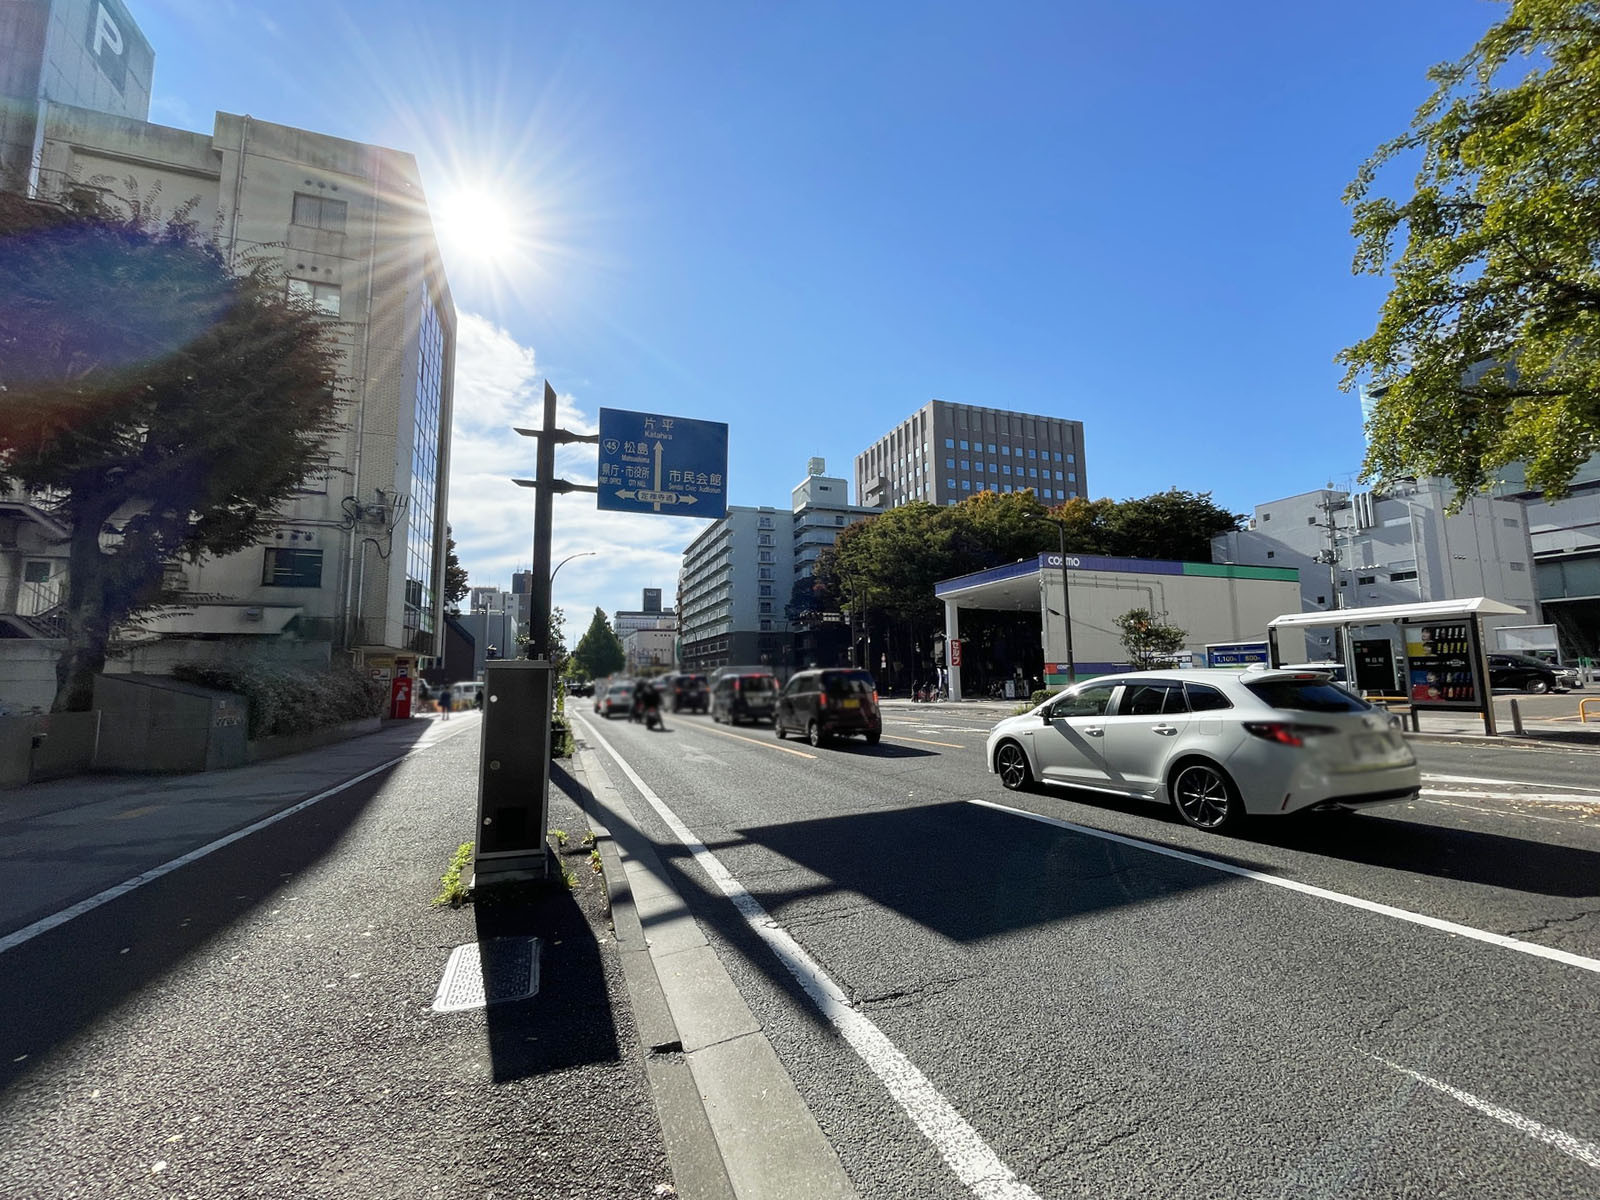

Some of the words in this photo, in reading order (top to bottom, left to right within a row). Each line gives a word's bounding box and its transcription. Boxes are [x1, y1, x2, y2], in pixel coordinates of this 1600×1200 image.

[93, 1, 123, 55] P
[645, 417, 674, 431] 片平
[645, 431, 672, 440] Katahira
[606, 441, 616, 450] 45
[624, 441, 648, 455] 松島
[669, 470, 721, 486] 市民会館
[952, 641, 960, 665] セルフ
